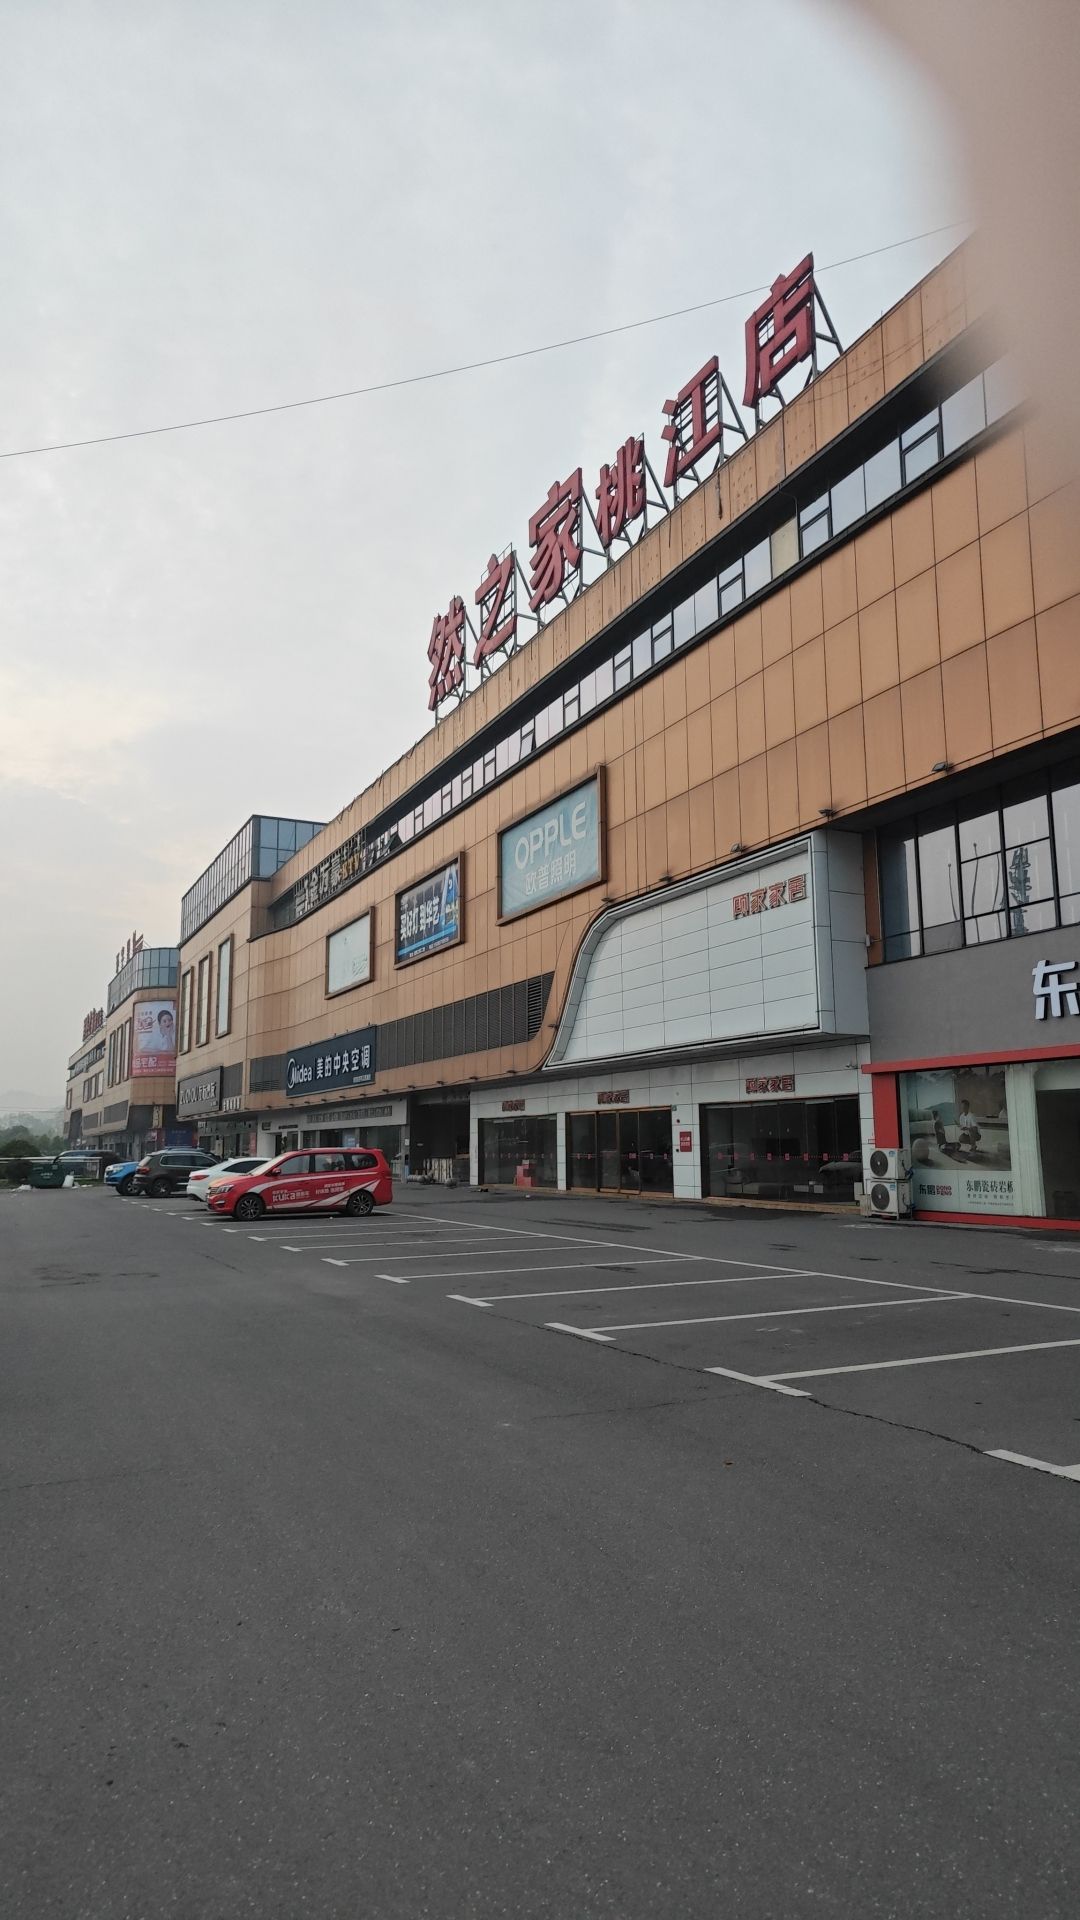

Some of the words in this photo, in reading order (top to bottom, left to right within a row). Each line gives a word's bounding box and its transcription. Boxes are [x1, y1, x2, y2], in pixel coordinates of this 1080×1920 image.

[515, 801, 586, 869] OPPLE
[525, 850, 577, 896] 欧普照明
[733, 874, 806, 919] 顾家家居
[1032, 960, 1079, 1020] 东
[287, 1058, 313, 1089] Midea
[316, 1045, 371, 1079] 美的中央空调
[746, 1074, 795, 1094] 顾家家居
[919, 1184, 935, 1196] 东鹏
